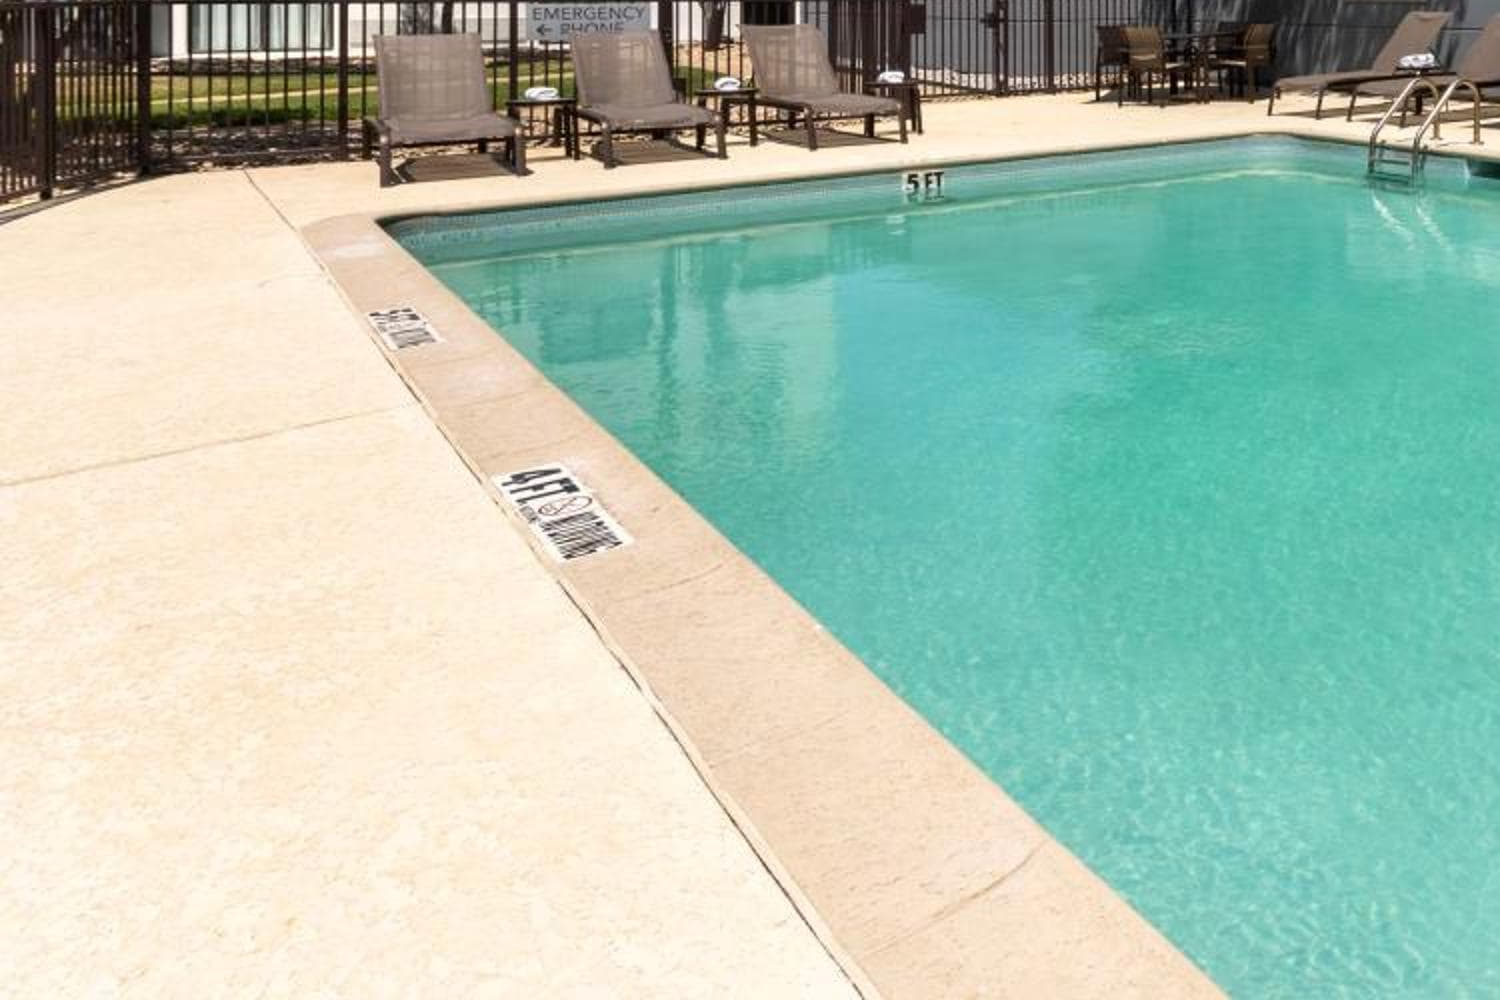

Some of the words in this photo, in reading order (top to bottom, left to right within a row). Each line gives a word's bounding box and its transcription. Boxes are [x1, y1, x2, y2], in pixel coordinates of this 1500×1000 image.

[532, 6, 645, 22] EMERGENCY
[559, 22, 625, 35] PHONE
[906, 173, 919, 190] 5
